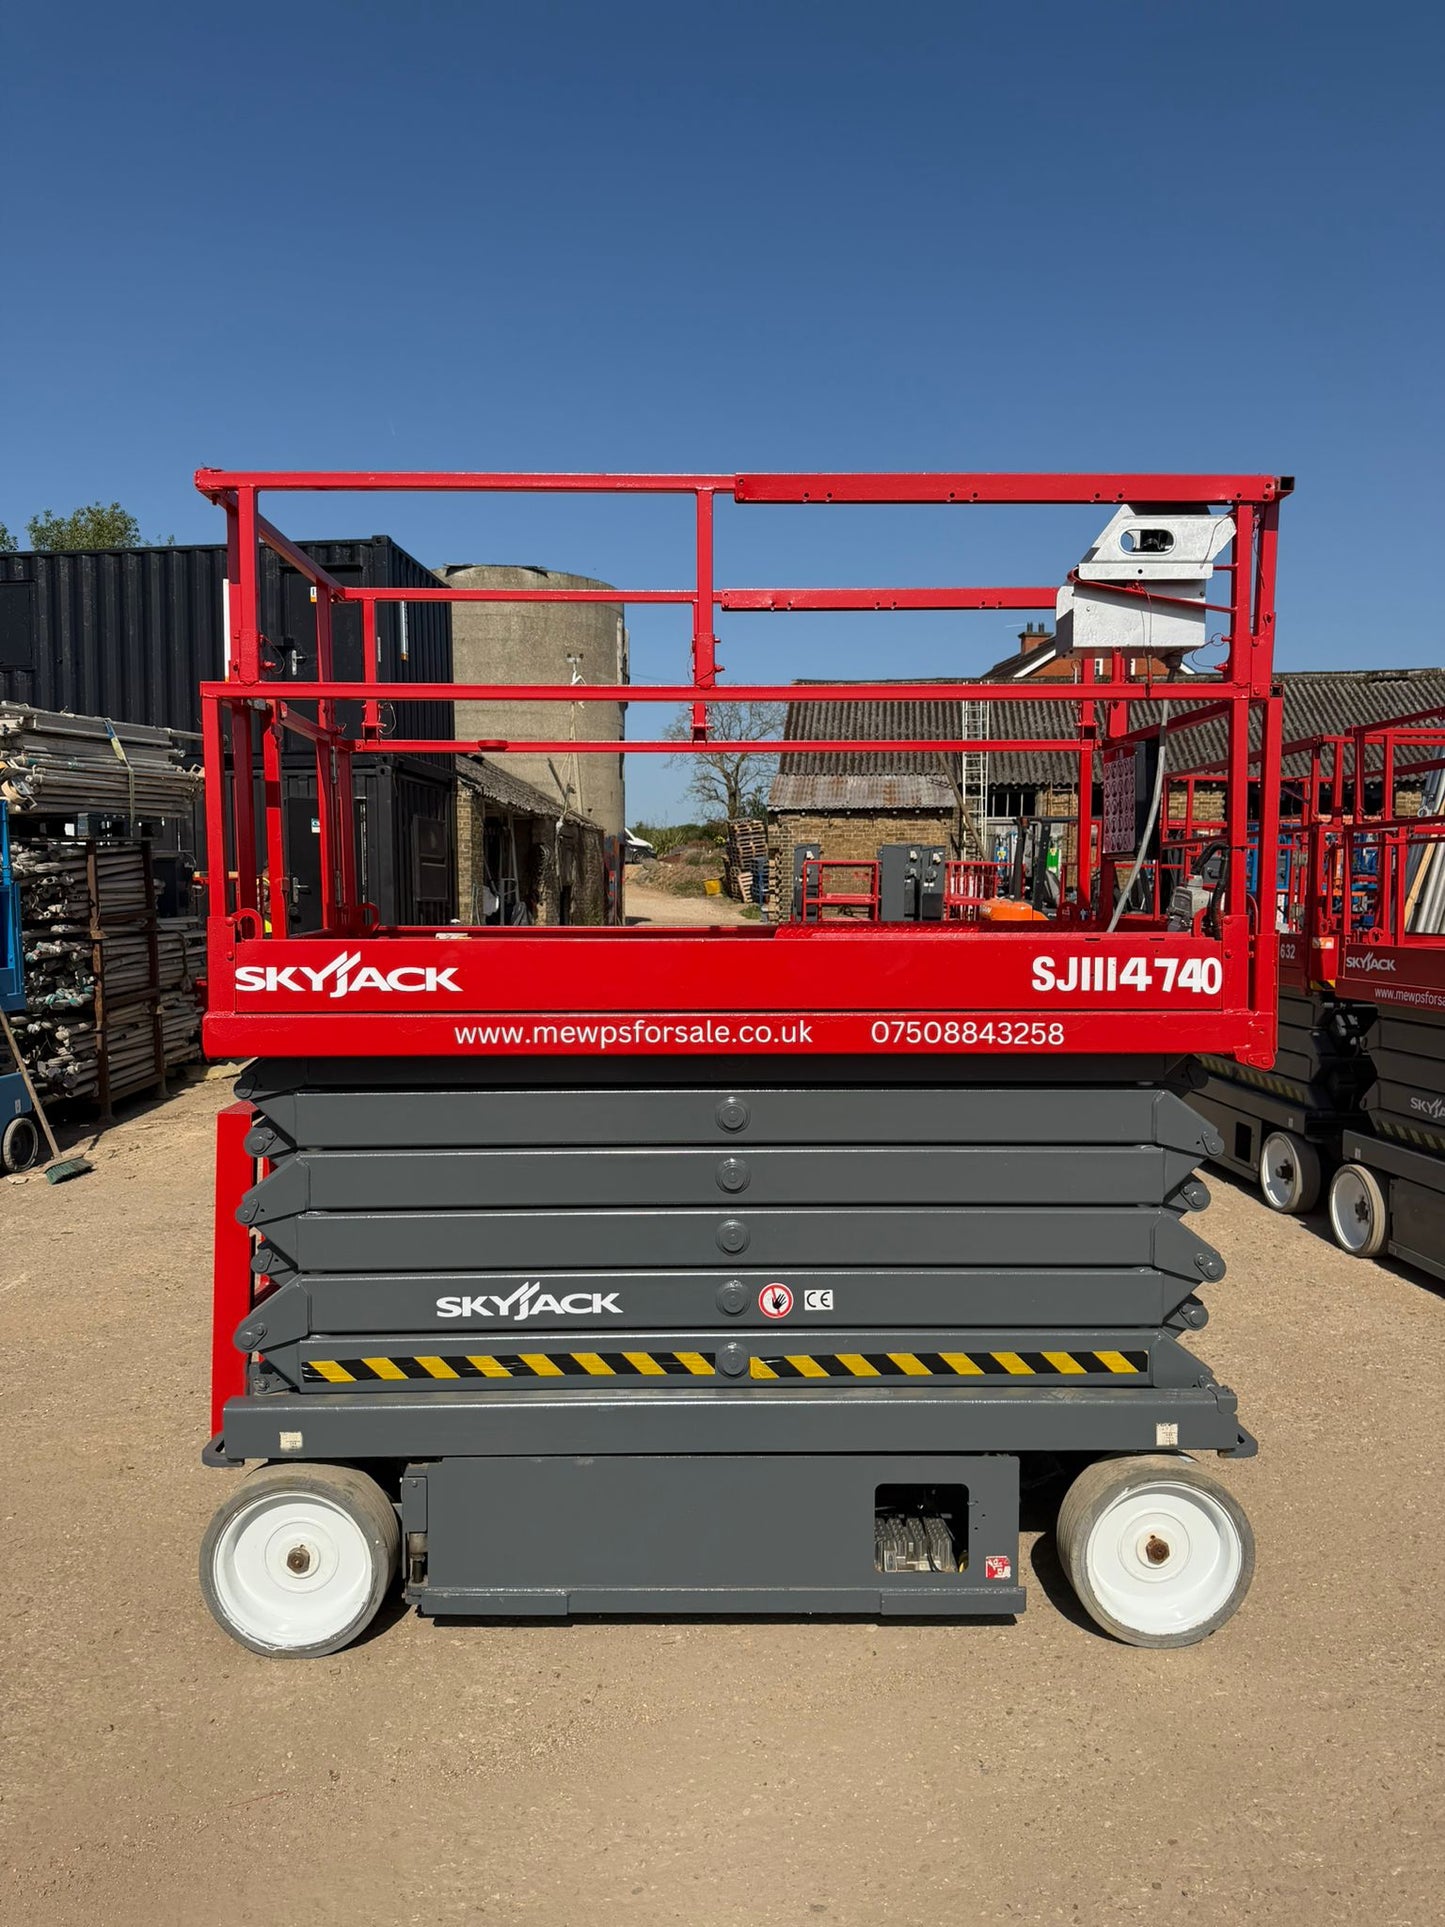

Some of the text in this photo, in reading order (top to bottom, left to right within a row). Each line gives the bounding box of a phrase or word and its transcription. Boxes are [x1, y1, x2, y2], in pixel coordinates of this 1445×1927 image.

[235, 951, 464, 998] SKYJACK
[1345, 952, 1397, 972] SKYJACK
[454, 1020, 1065, 1049] www.mewpsforsale.co.uk 07508843258
[436, 1281, 623, 1321] SKYJACK
[806, 1291, 831, 1308] CE
